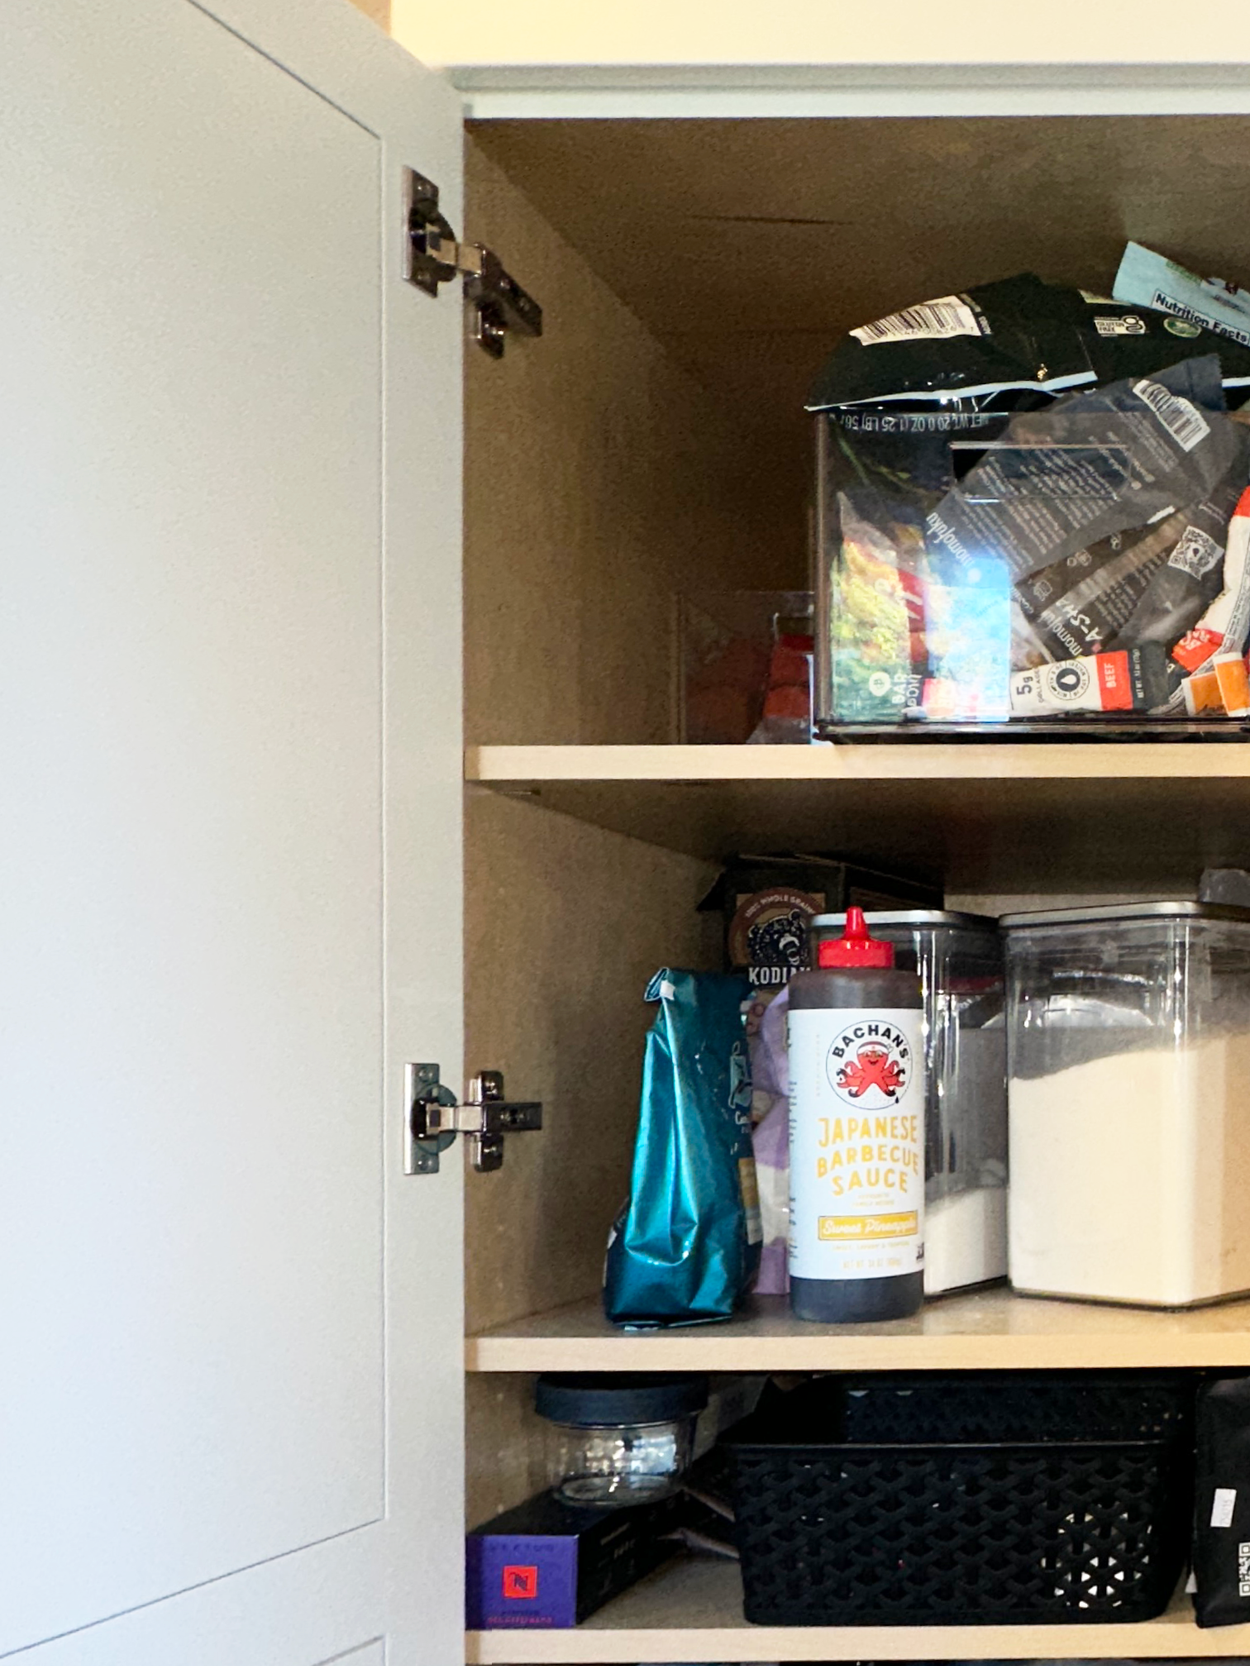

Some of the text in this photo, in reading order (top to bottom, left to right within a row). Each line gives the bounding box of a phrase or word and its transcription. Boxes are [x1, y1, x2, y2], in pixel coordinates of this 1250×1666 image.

[1155, 293, 1209, 328] Nutrition
[1212, 321, 1249, 344] Facts
[911, 416, 926, 431] OZ
[1017, 676, 1034, 695] 5g
[1104, 662, 1116, 689] BEEF
[748, 966, 811, 985] KODI
[818, 1115, 918, 1147] JAPANESE
[817, 1144, 919, 1178] BARBECUE
[831, 1168, 908, 1197] SAUCE
[823, 1220, 862, 1235] Sweet
